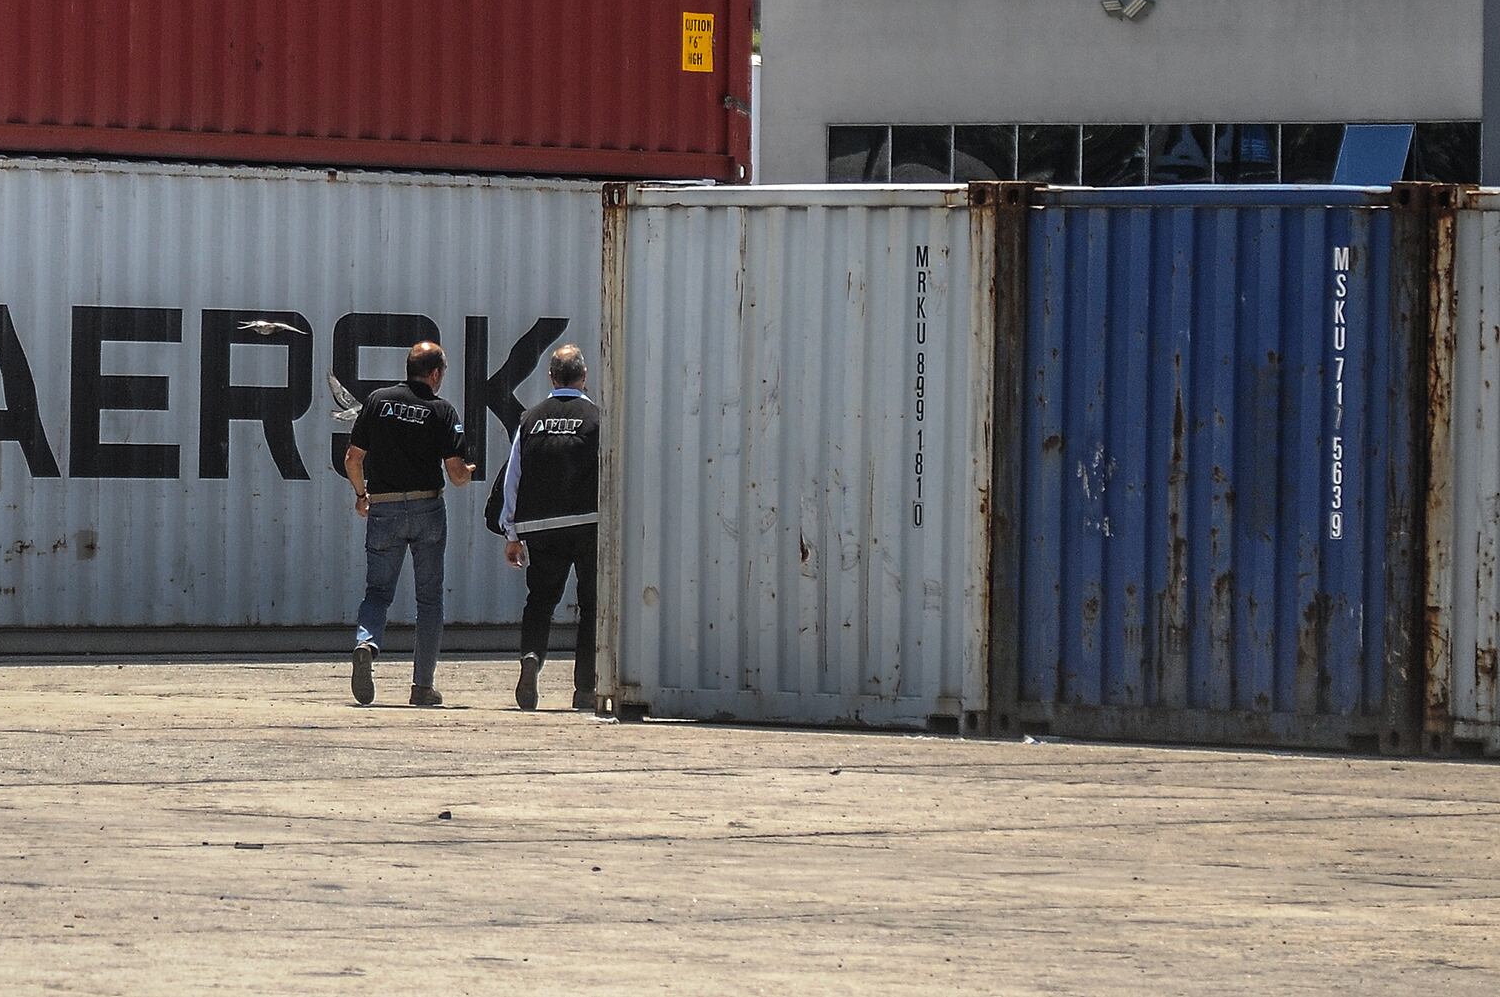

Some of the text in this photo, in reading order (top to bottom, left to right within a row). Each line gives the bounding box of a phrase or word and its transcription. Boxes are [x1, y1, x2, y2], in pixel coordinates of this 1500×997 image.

[913, 245, 929, 527] MRKU 899 181 0
[1330, 247, 1349, 539] MSKU 717 563 9
